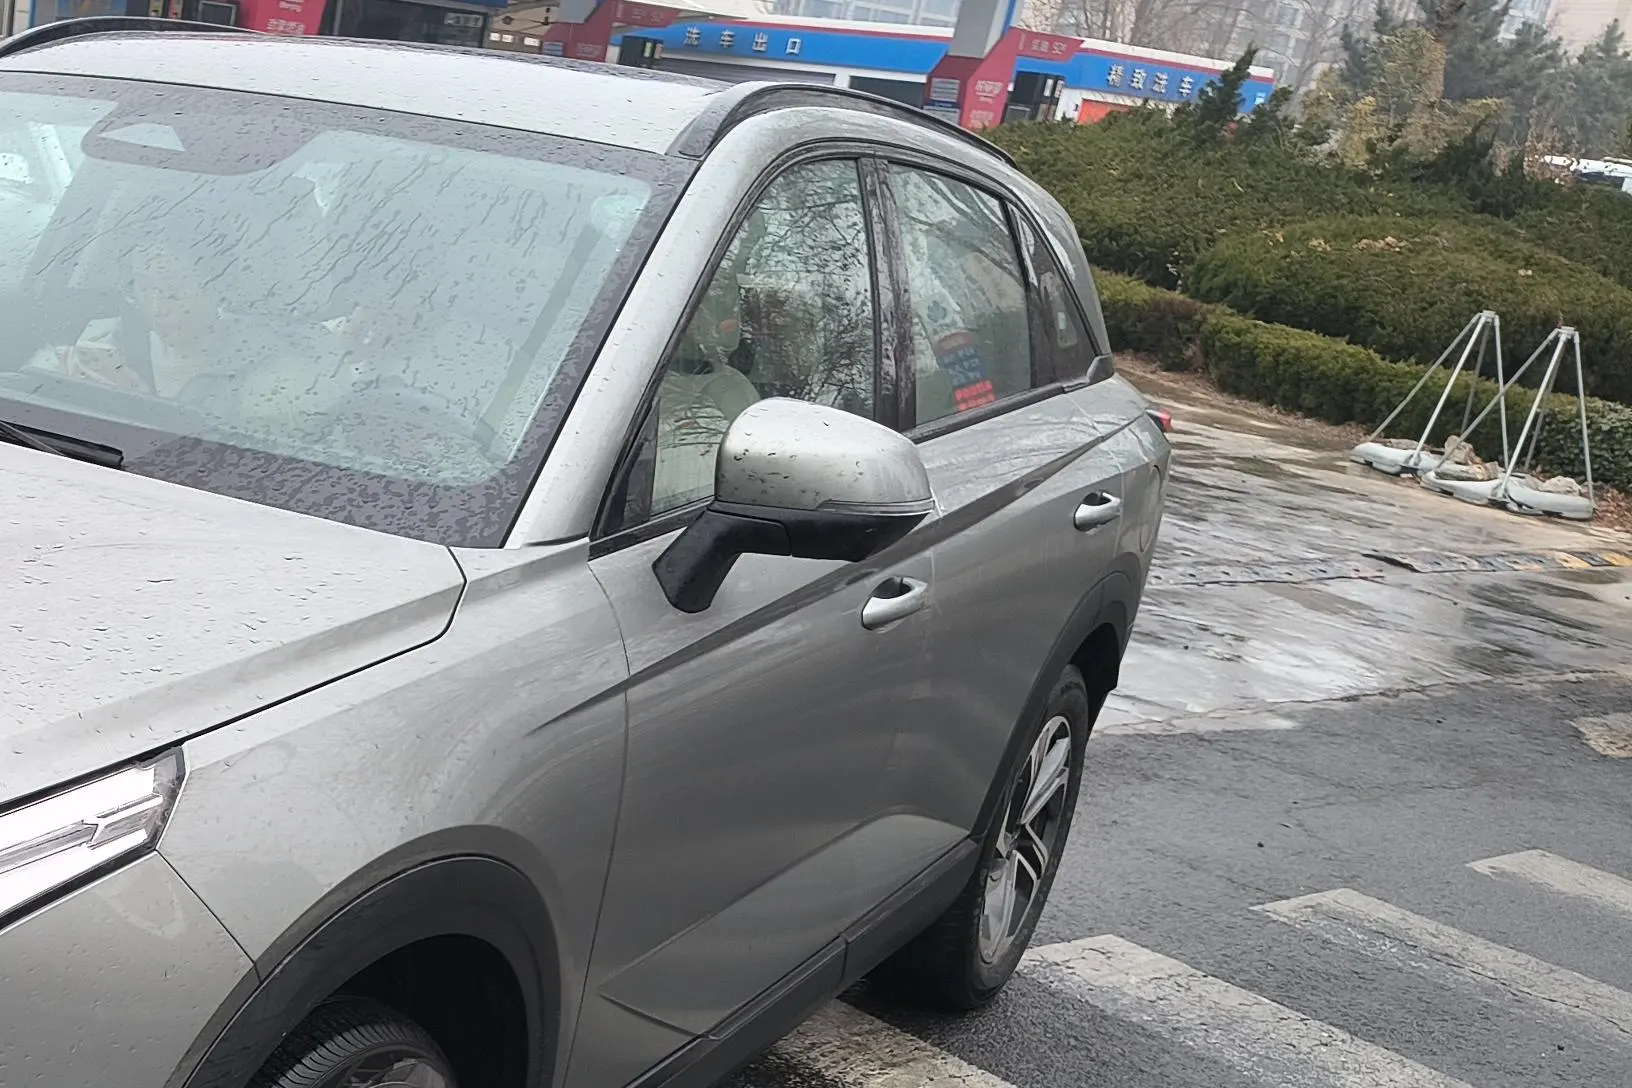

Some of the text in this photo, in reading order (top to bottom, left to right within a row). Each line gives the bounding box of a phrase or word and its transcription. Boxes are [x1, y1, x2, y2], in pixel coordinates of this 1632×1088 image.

[683, 25, 802, 55] 洗车出口
[1106, 63, 1194, 98] 精致洗车
